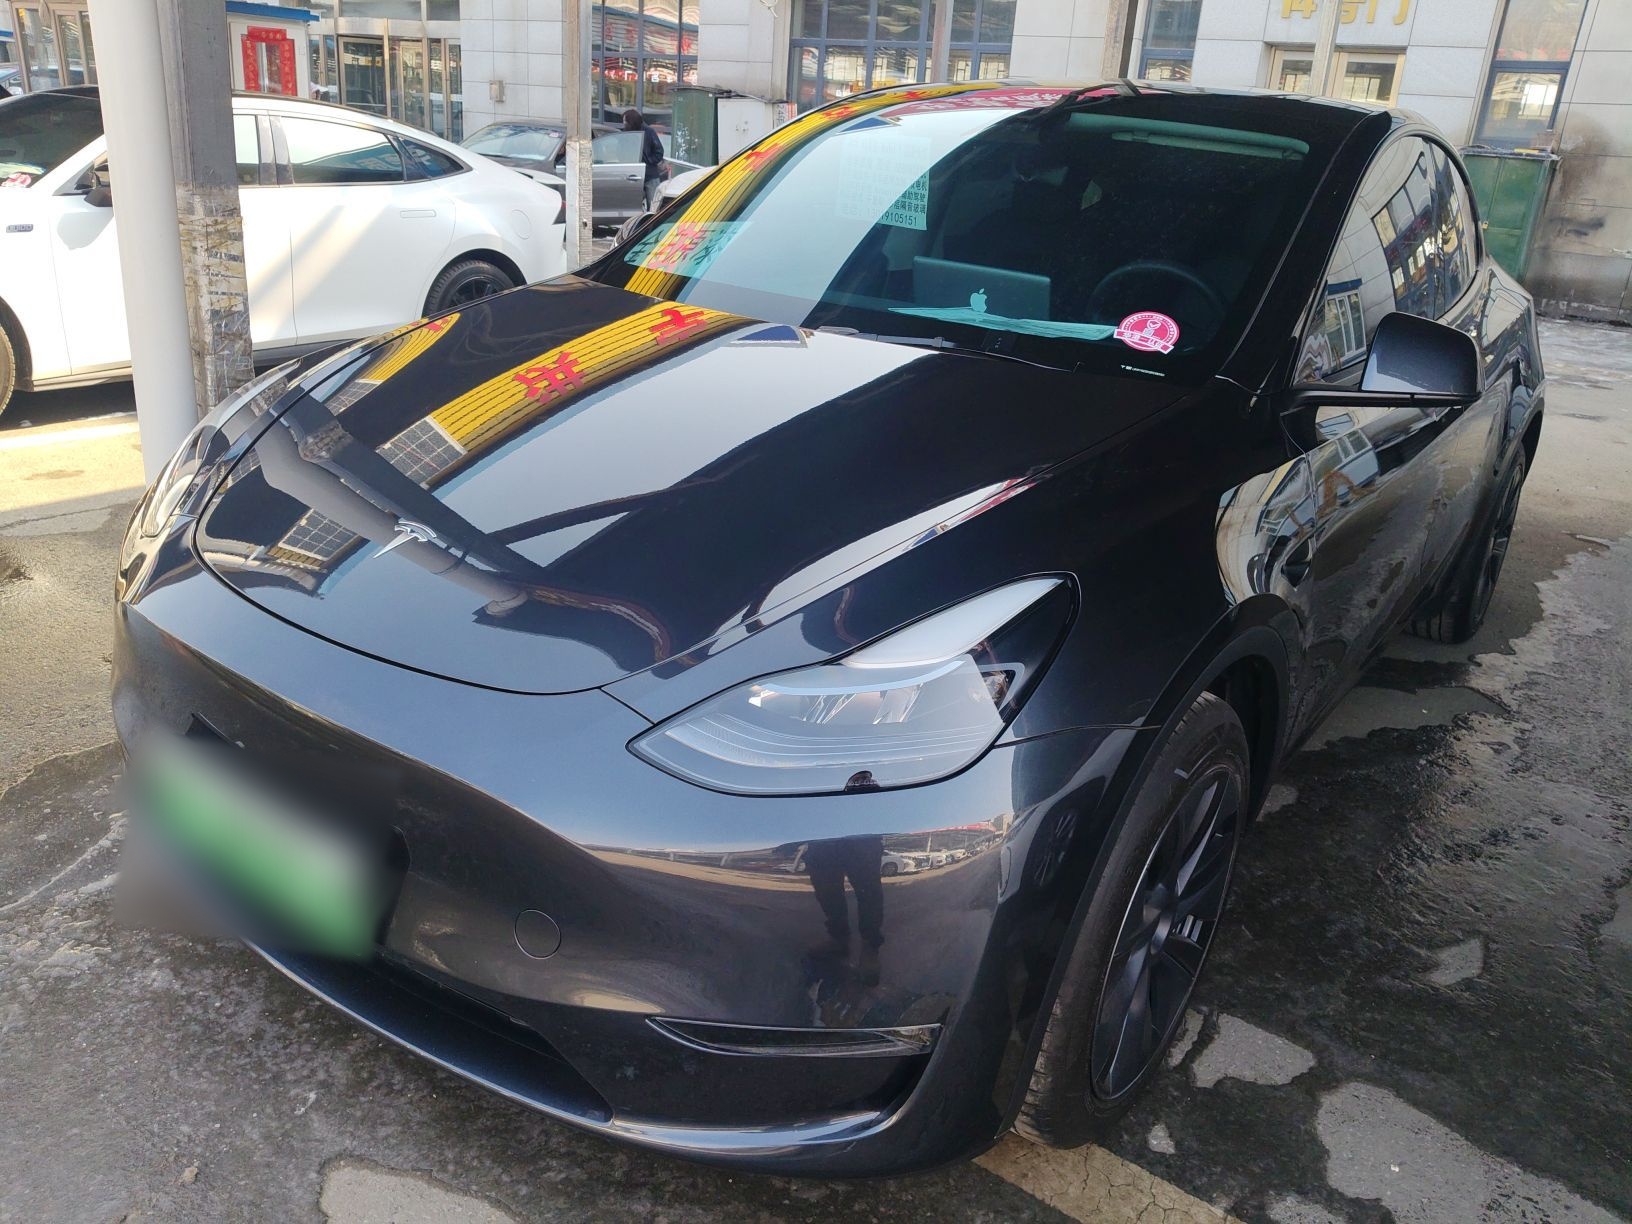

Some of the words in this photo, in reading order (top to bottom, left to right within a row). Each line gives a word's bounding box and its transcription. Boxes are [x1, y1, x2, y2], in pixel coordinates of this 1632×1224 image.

[891, 200, 926, 214] 层隔音玻璃
